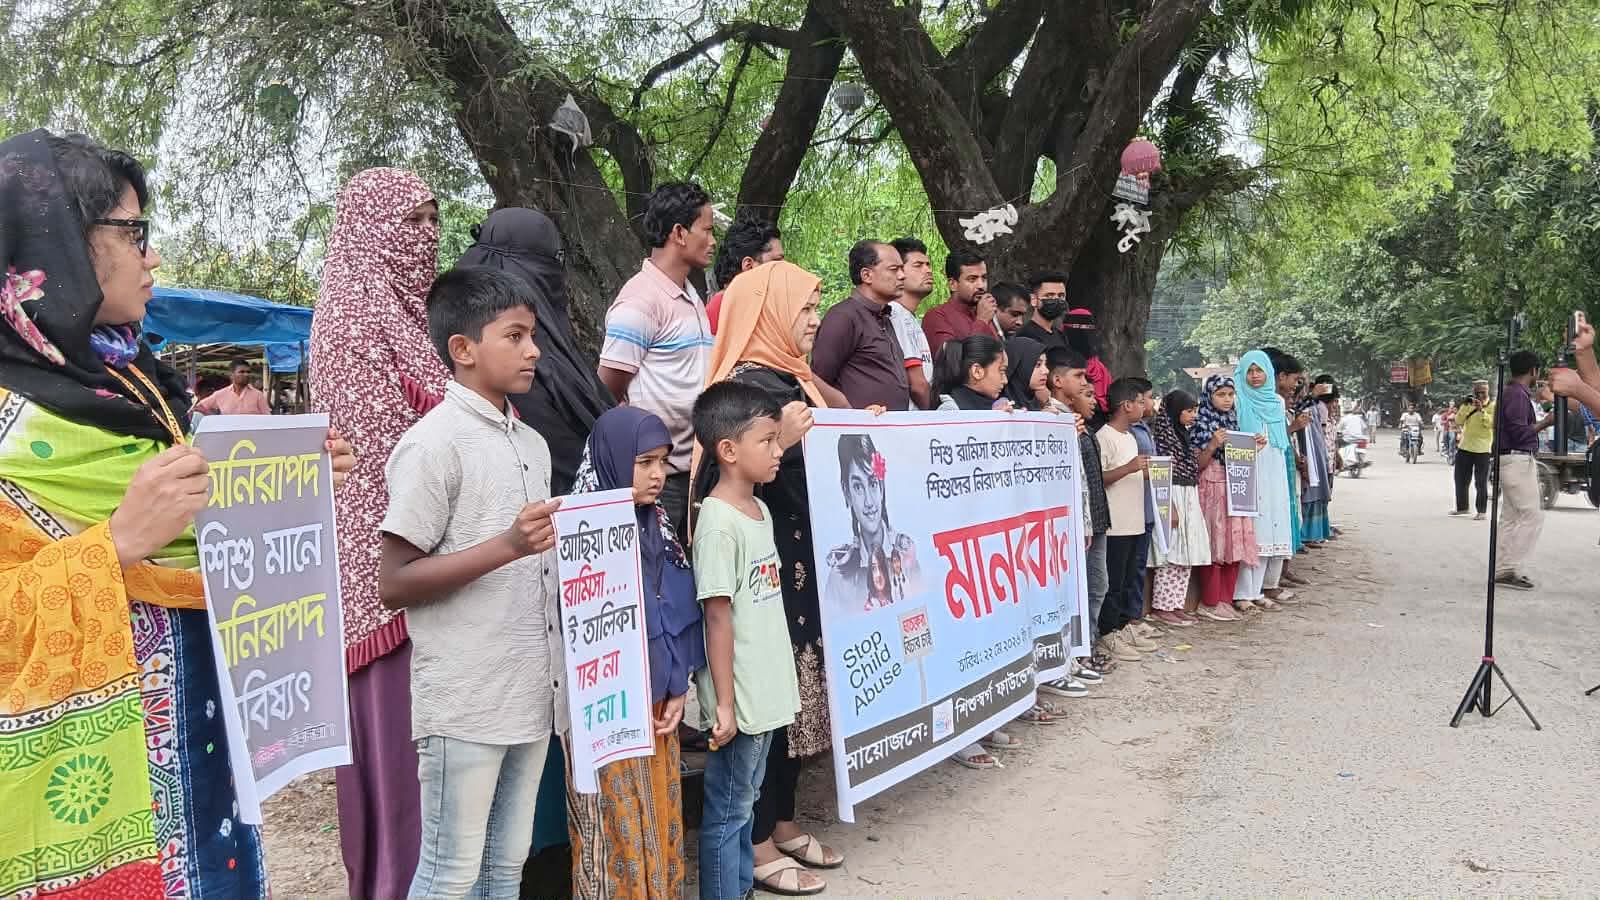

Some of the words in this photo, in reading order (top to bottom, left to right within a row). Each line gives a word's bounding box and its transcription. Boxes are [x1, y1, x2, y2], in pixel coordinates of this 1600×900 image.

[930, 438, 953, 465] শিশু
[955, 436, 988, 462] রামিসা
[926, 471, 971, 499] শিশুদের
[973, 466, 1012, 492] নিরাপত্তা
[1231, 480, 1248, 496] চাই
[200, 520, 255, 591] শিশু
[262, 522, 323, 576] মানে
[560, 520, 603, 564] আছিয়া
[608, 522, 635, 552] থেকে
[583, 601, 637, 645] তালিকা
[602, 649, 621, 679] না
[843, 631, 882, 668] Stop
[850, 643, 891, 688] Child
[855, 662, 902, 716] Abuse
